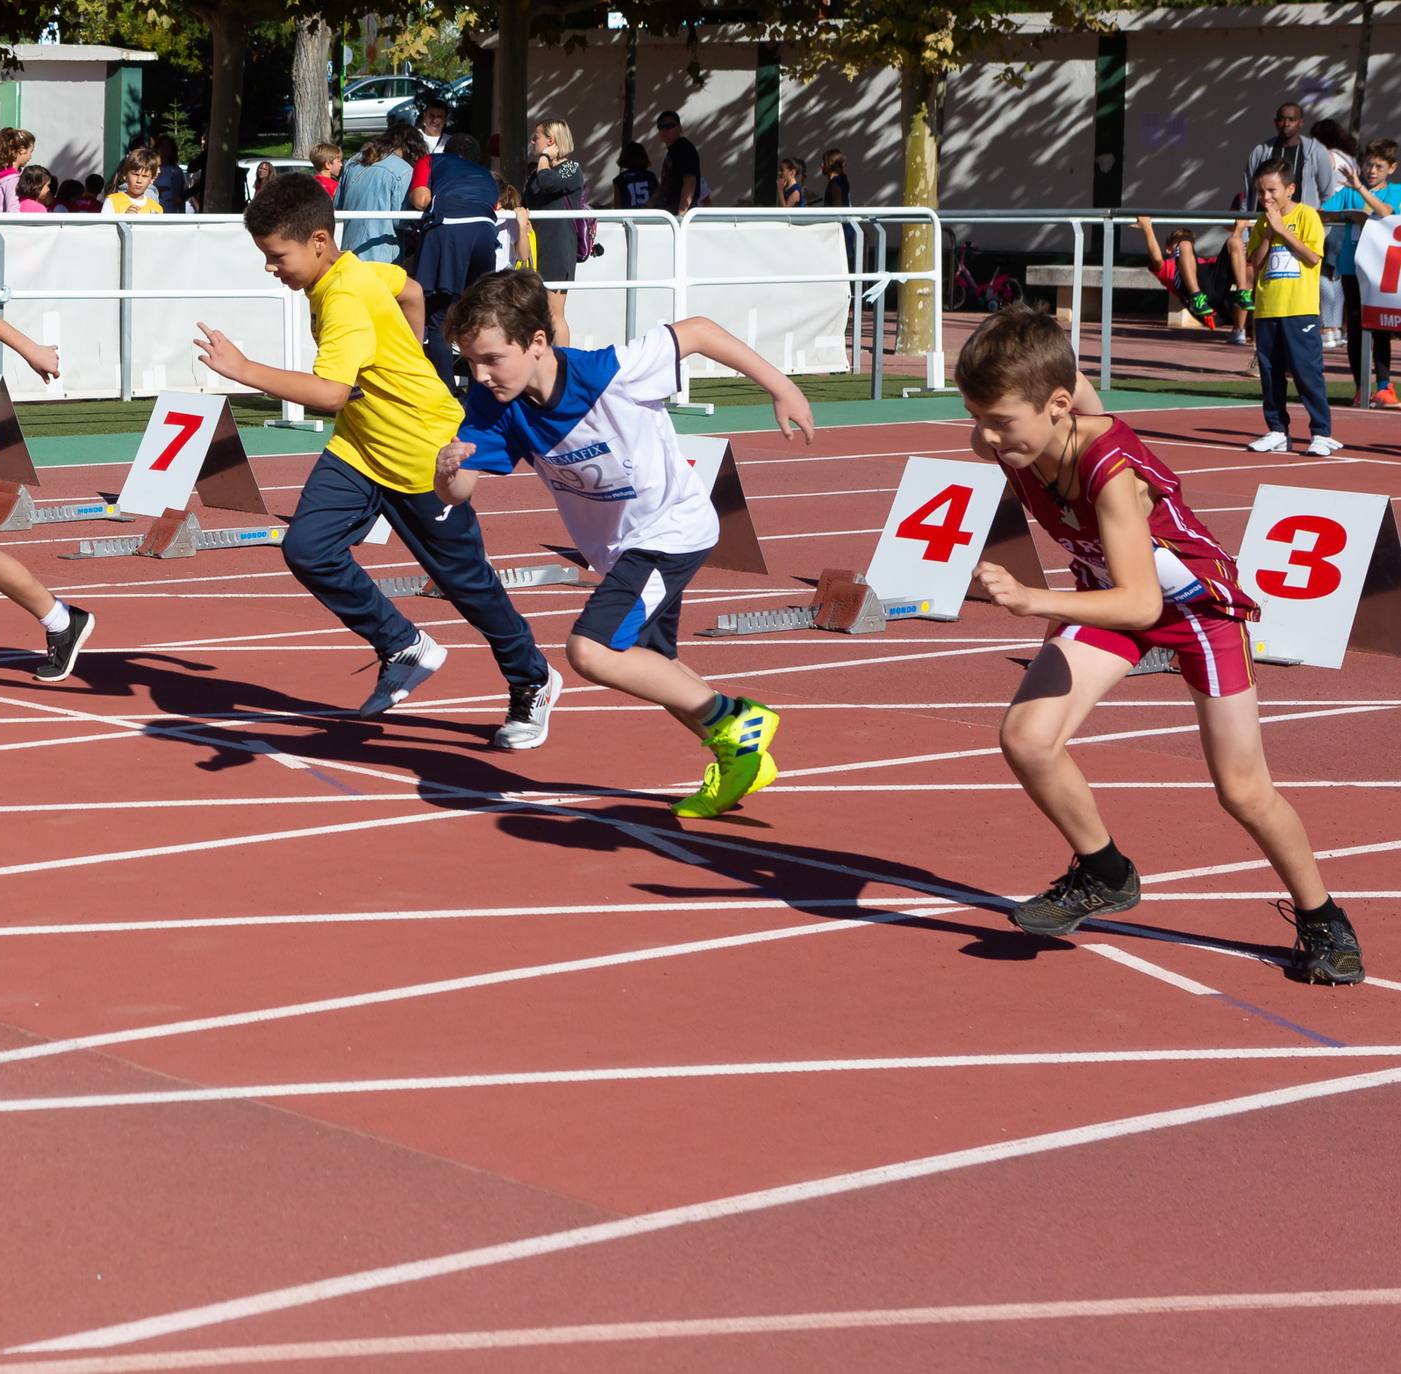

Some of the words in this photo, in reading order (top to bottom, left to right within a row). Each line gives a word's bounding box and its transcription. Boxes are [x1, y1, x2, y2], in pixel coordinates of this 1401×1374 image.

[149, 411, 204, 471] 7
[78, 506, 103, 514] MONDO
[895, 483, 974, 563] 4
[240, 531, 267, 539] MONDO
[1255, 514, 1348, 600] 3
[889, 606, 916, 615] MONDO
